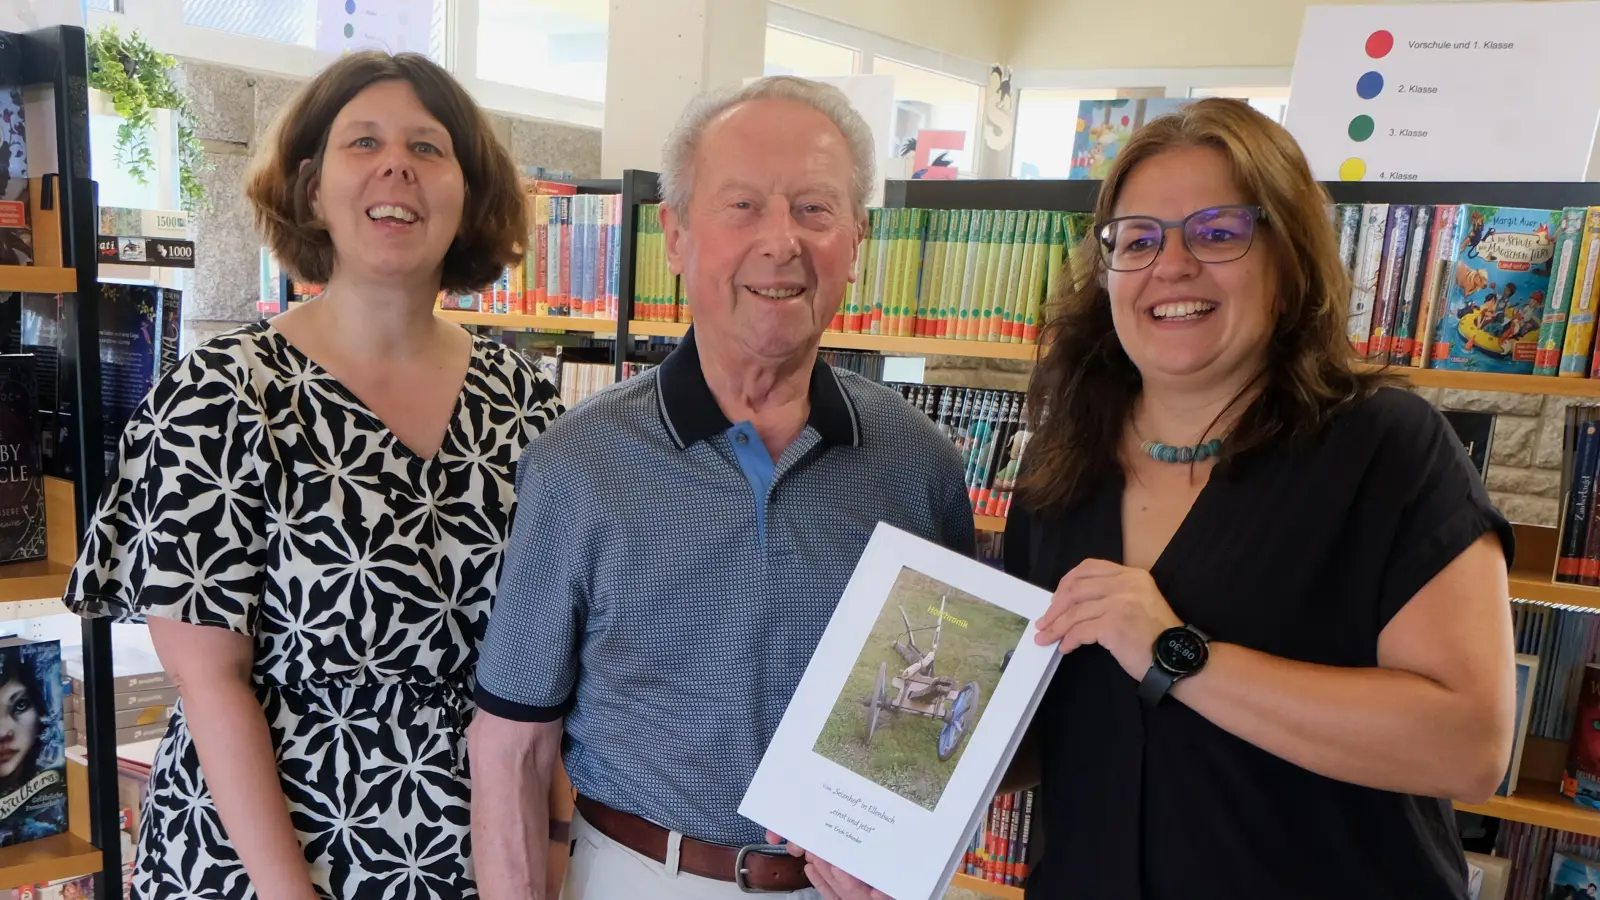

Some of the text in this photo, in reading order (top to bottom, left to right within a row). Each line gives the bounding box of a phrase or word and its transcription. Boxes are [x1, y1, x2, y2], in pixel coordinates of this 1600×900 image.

[1408, 40, 1514, 50] Vorschule und 1. Klasse
[1397, 84, 1438, 94] 2. Klasse
[1389, 128, 1428, 138] 3. Klasse
[1379, 171, 1418, 181] 4. Klasse
[157, 215, 176, 228] 1500
[1493, 216, 1538, 228] Margit Auer
[168, 245, 192, 258] 1000
[1168, 640, 1195, 660] 08:30
[860, 802, 868, 811] in
[847, 816, 860, 827] und
